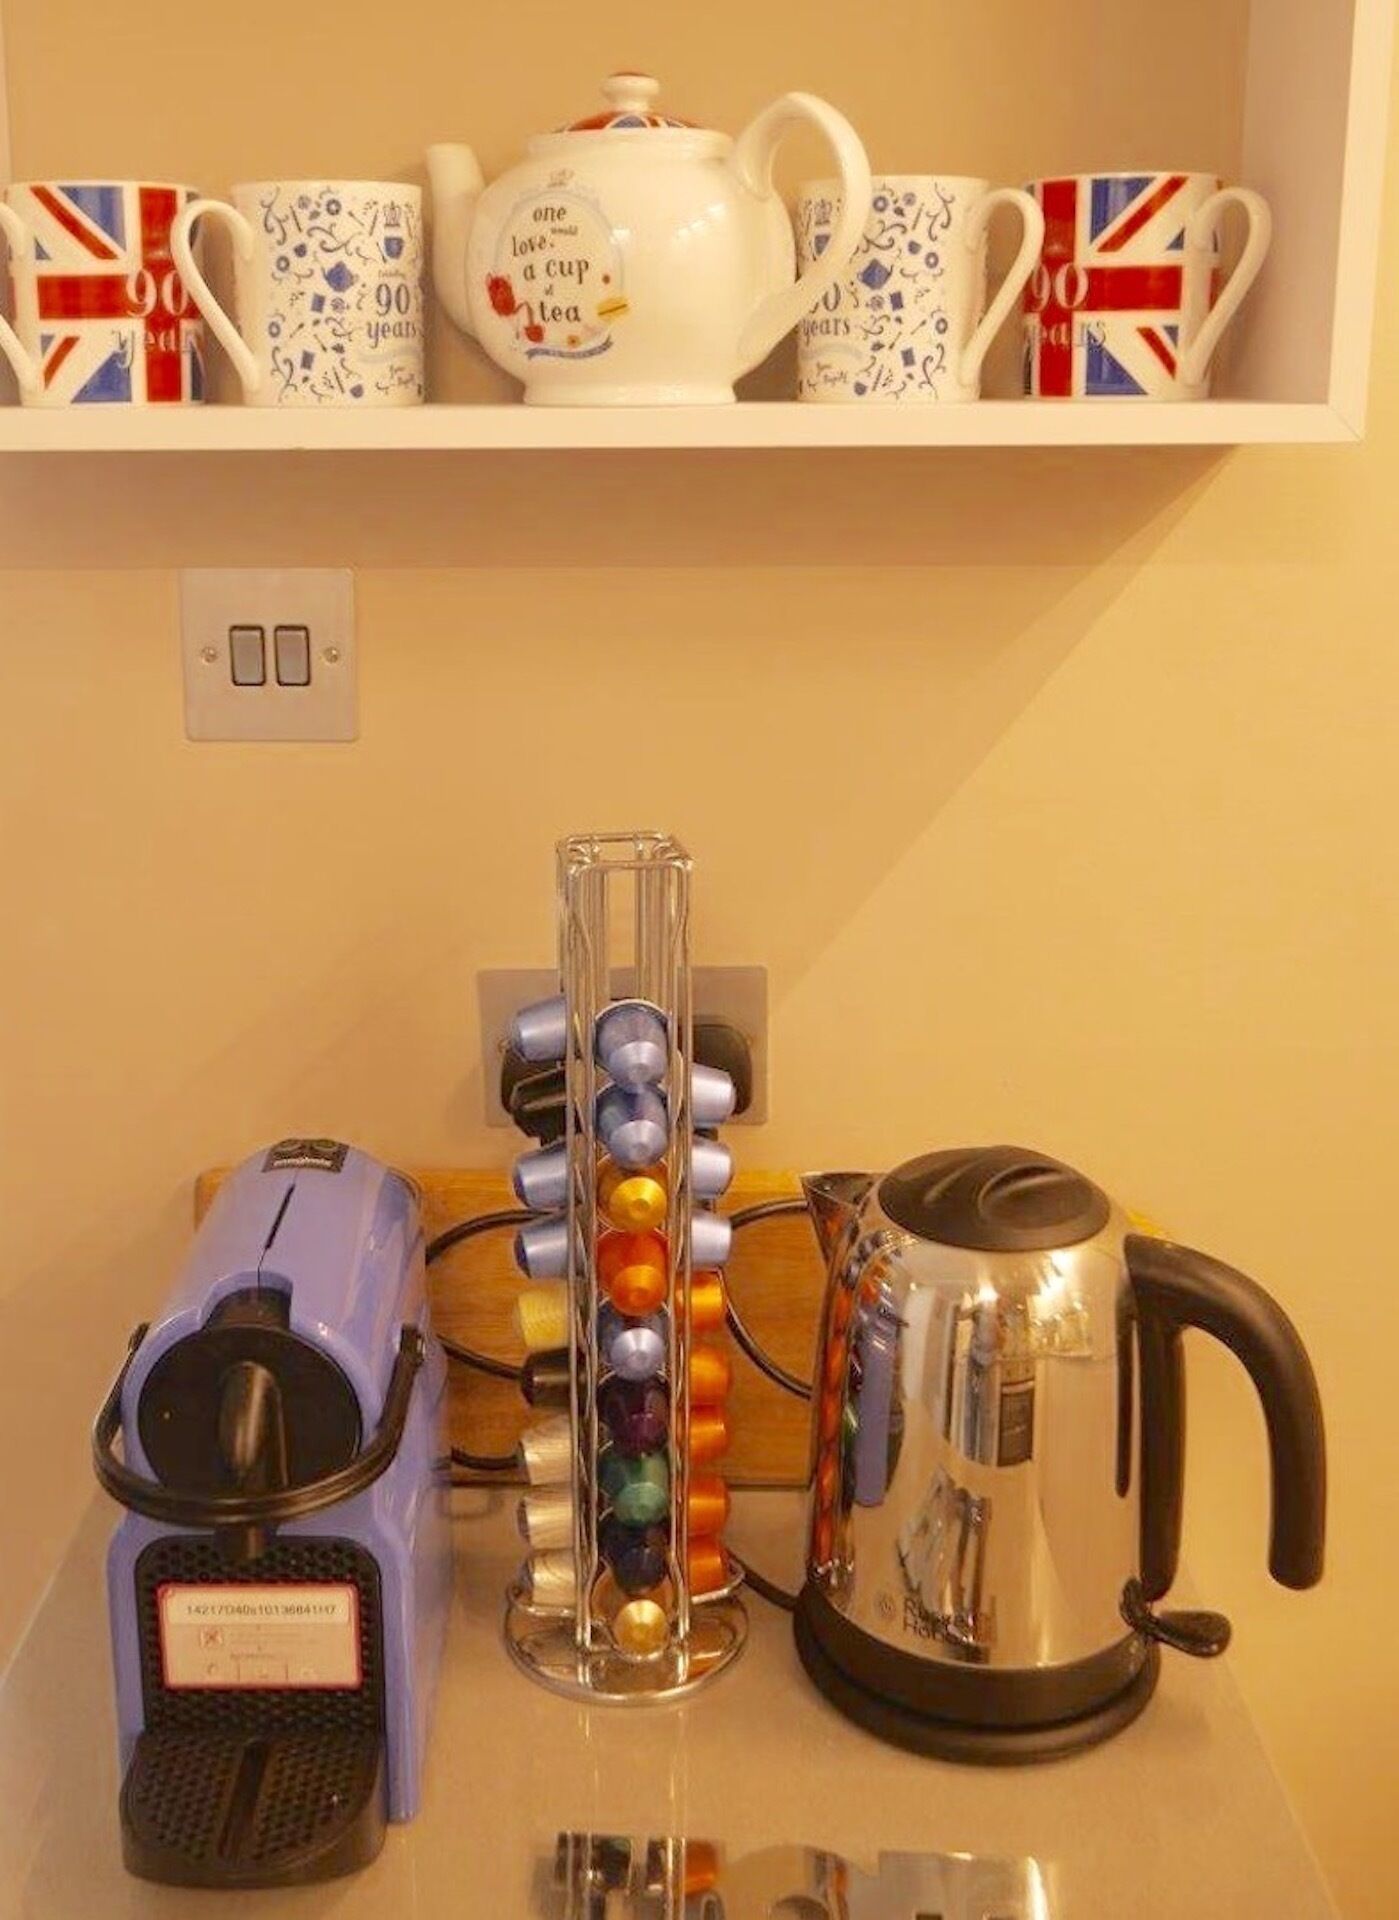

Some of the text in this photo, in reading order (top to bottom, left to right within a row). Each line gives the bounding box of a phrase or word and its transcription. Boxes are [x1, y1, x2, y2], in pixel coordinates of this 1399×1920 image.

[532, 206, 568, 223] one
[523, 258, 590, 285] a cup
[125, 269, 188, 318] 90
[375, 283, 410, 316] 90
[1031, 262, 1089, 312] 90
[539, 301, 582, 323] tea
[366, 320, 417, 349] years
[801, 317, 850, 346] years
